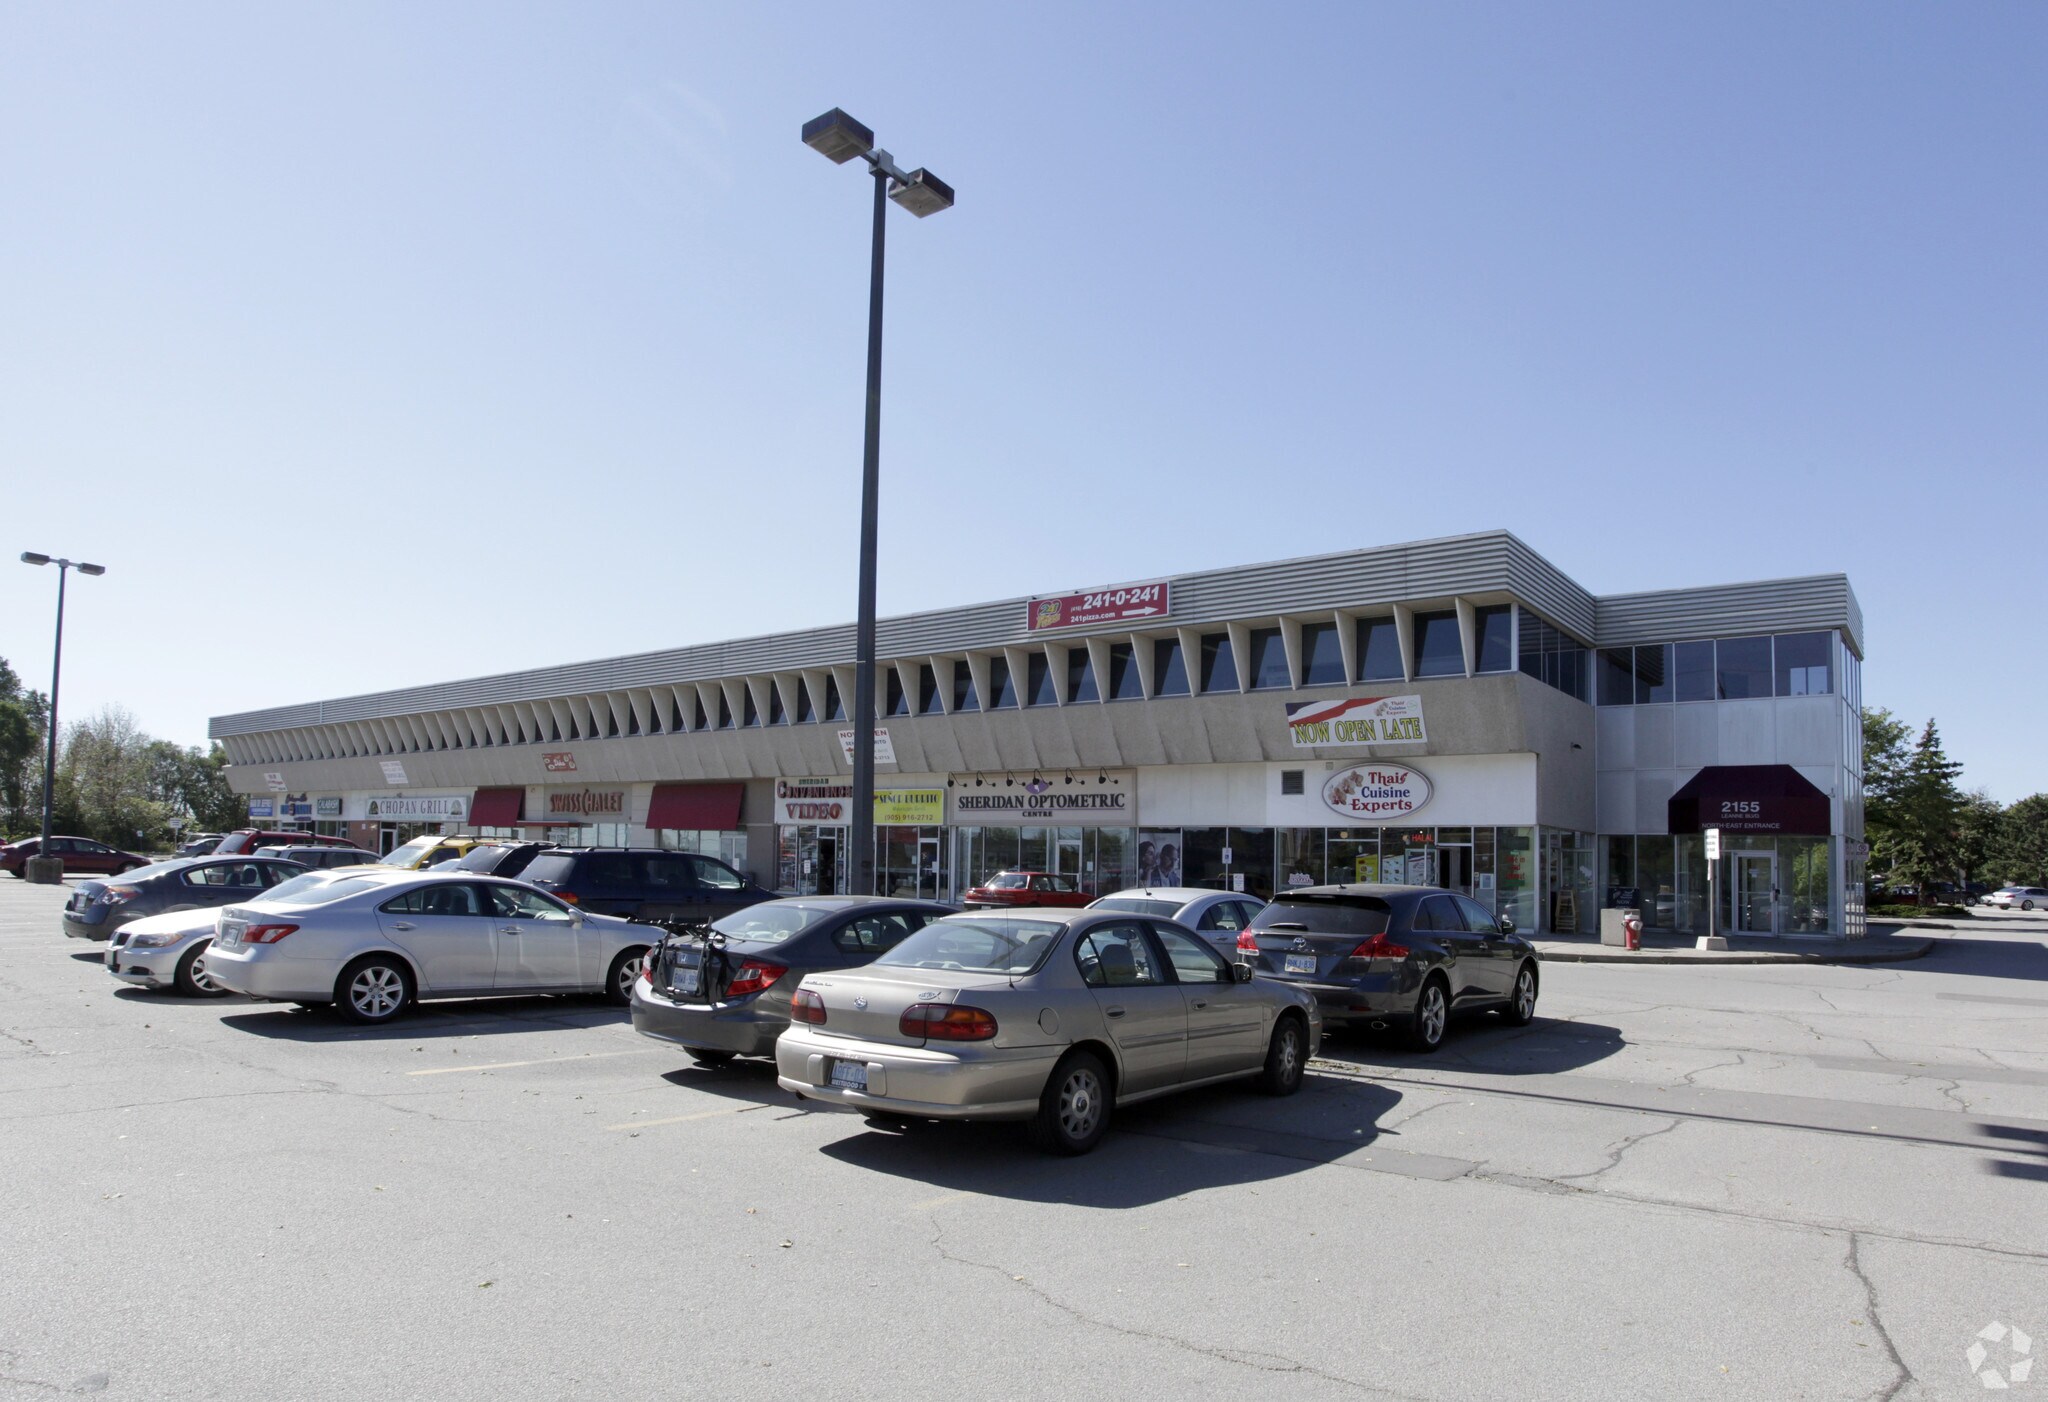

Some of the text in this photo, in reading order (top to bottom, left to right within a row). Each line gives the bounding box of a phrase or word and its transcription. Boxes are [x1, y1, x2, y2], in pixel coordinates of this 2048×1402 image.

[1082, 585, 1160, 610] 241-0-241
[1070, 611, 1116, 623] 241pizza.com
[1294, 717, 1423, 743] NOW OPEN LATE
[1368, 772, 1401, 786] Thai
[1361, 786, 1411, 798] Cuisine
[380, 799, 449, 814] CHOPAN GRILL
[549, 793, 582, 813] SWISS
[958, 793, 1125, 809] SHERIDAN OPTOMETRIC
[1350, 798, 1413, 813] Experts
[1721, 801, 1760, 813] 2155
[785, 803, 843, 820] VIDEO
[884, 814, 901, 822] (905)
[1411, 834, 1434, 842] HALAL
